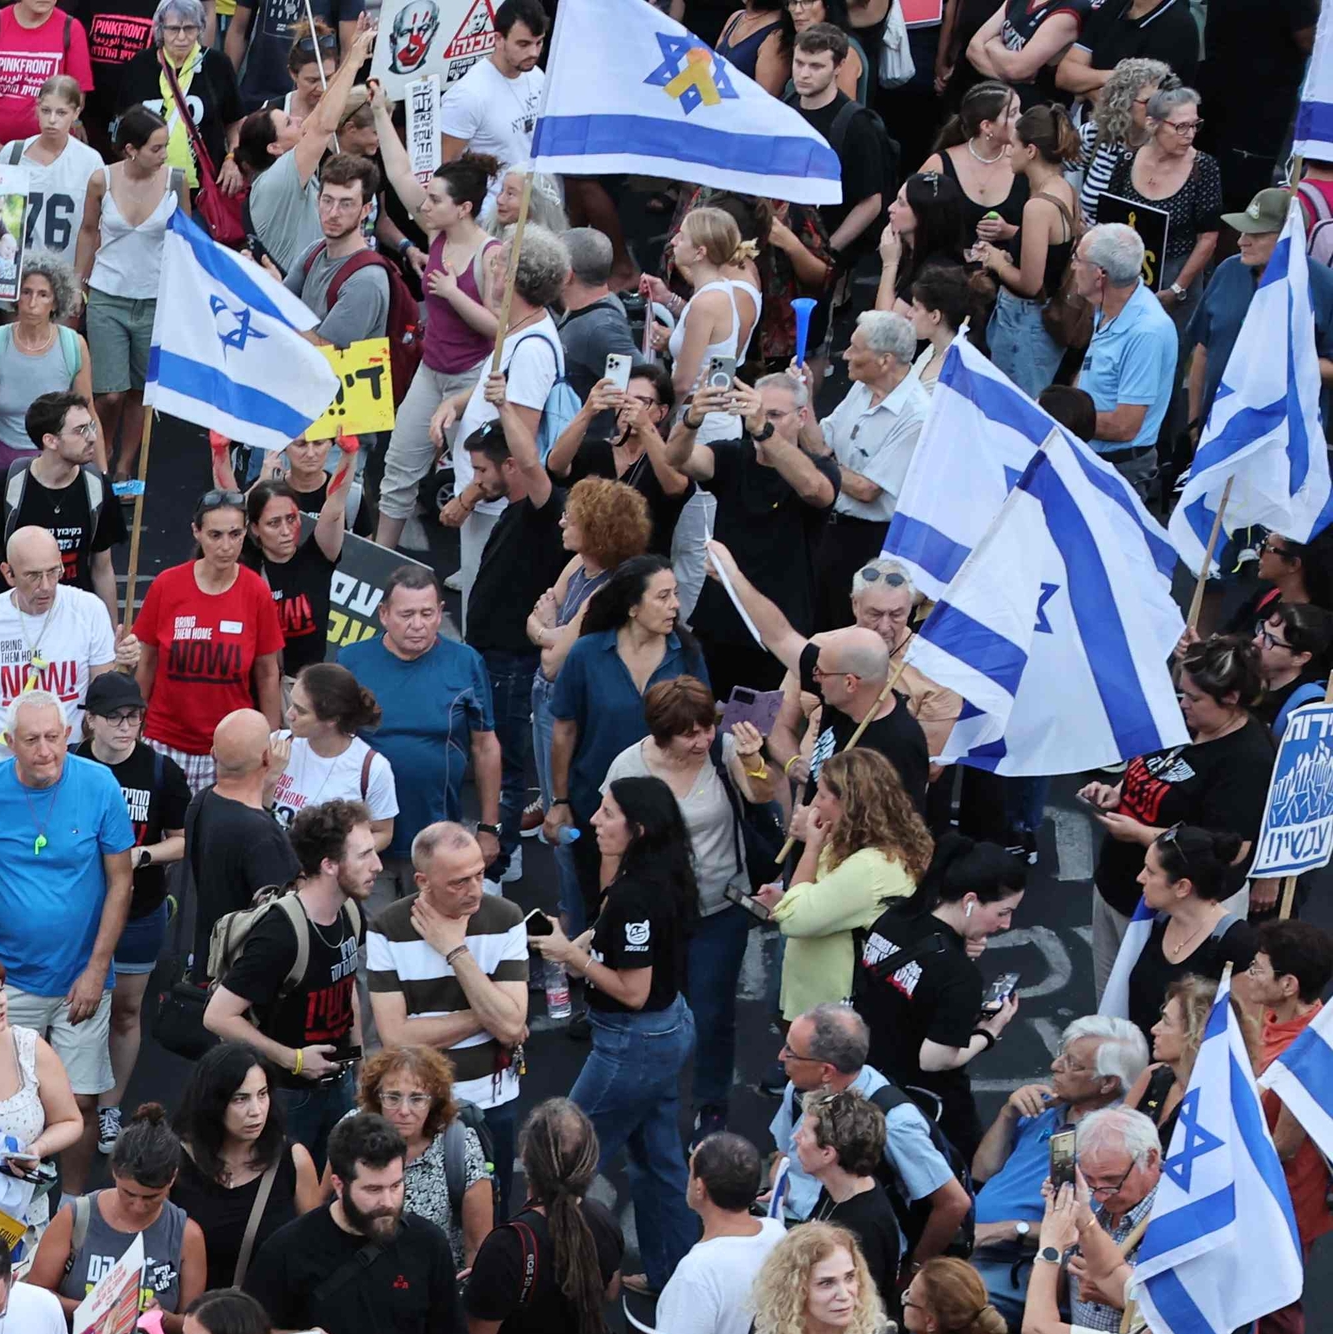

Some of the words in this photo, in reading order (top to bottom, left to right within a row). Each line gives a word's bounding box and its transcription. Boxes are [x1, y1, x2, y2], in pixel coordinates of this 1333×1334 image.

[24, 192, 75, 251] 76
[175, 616, 197, 629] BRING
[174, 628, 191, 640] THEM
[192, 628, 213, 640] HOME
[1, 639, 22, 654] BRING
[1, 649, 20, 663] THEM
[168, 641, 242, 676] NOW!
